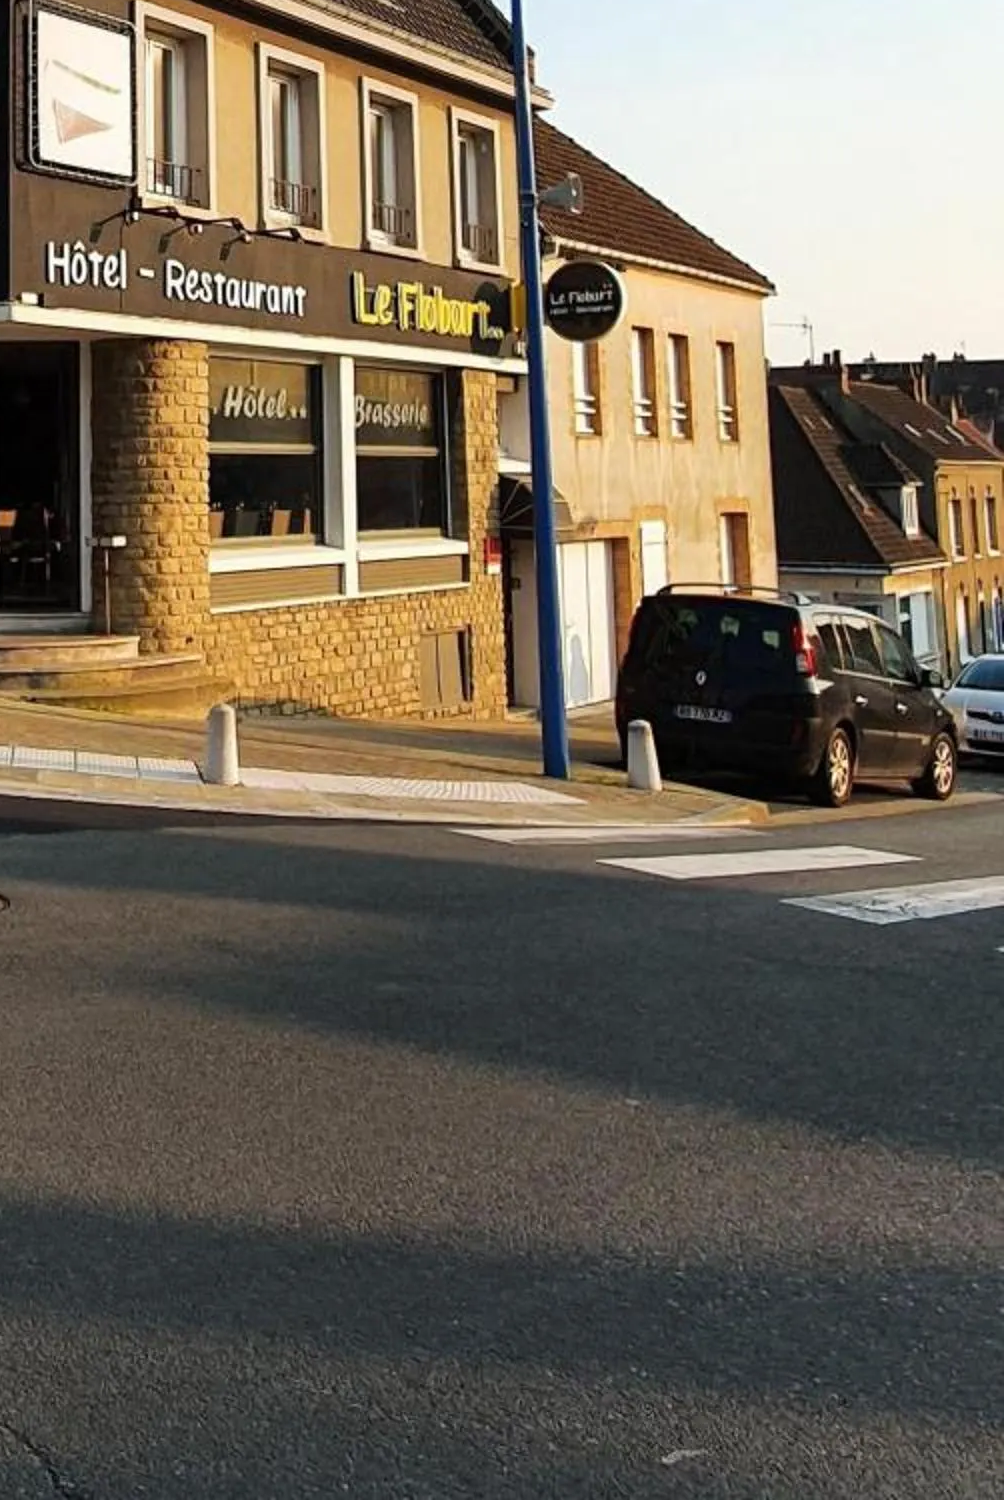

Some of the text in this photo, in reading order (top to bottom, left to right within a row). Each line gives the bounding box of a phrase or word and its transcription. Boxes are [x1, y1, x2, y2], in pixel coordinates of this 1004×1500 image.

[47, 240, 128, 289] Hôtel
[165, 258, 307, 317] Restaurant
[353, 271, 491, 339] Le Flobart
[223, 385, 287, 418] Hôtel
[355, 394, 429, 428] Brasserie
